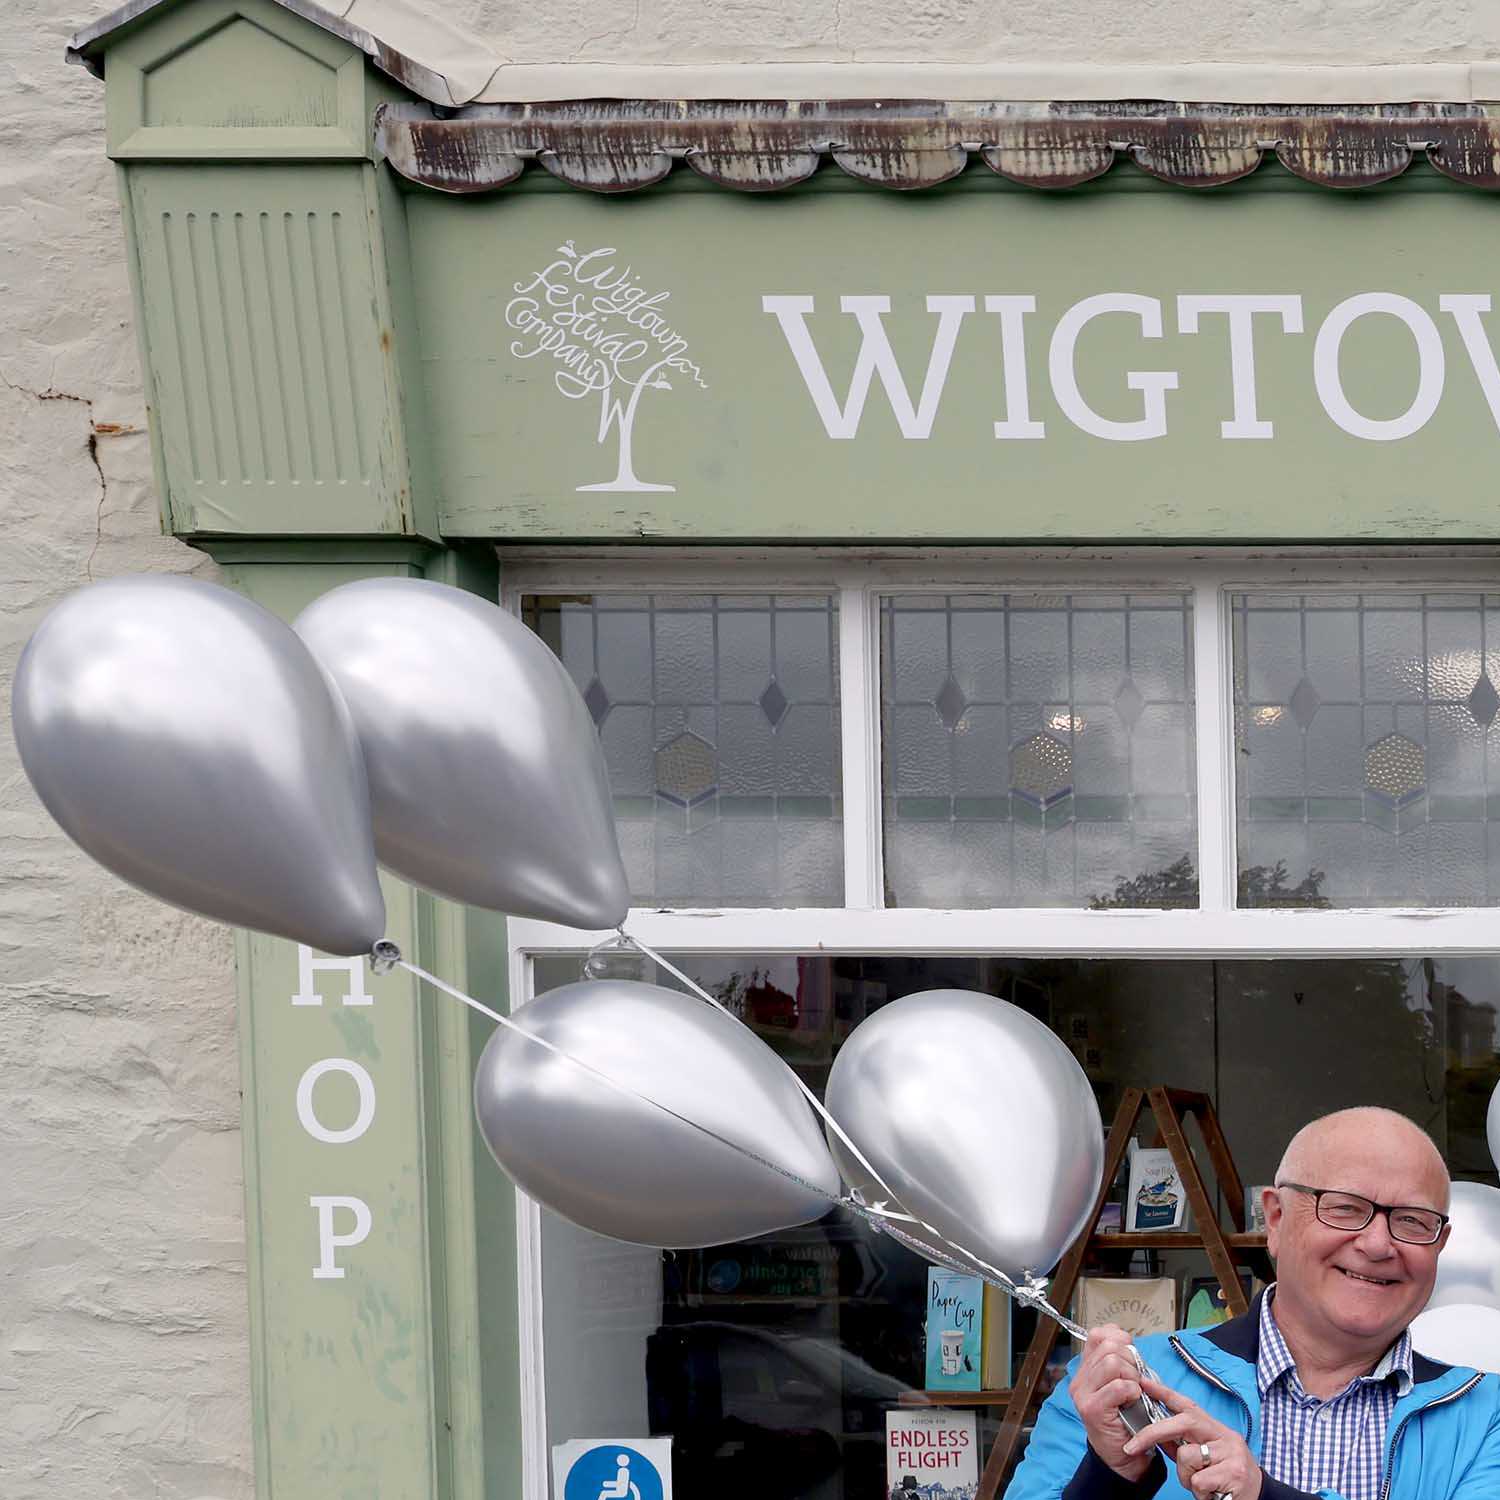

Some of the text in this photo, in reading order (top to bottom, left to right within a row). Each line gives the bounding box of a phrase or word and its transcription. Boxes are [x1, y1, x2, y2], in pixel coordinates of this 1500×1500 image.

[291, 943, 376, 1279] HOP
[931, 1280, 959, 1317] Paper
[955, 1301, 975, 1333] Cup
[890, 1430, 969, 1448] ENDLESS
[898, 1451, 962, 1468] FLIGHT
